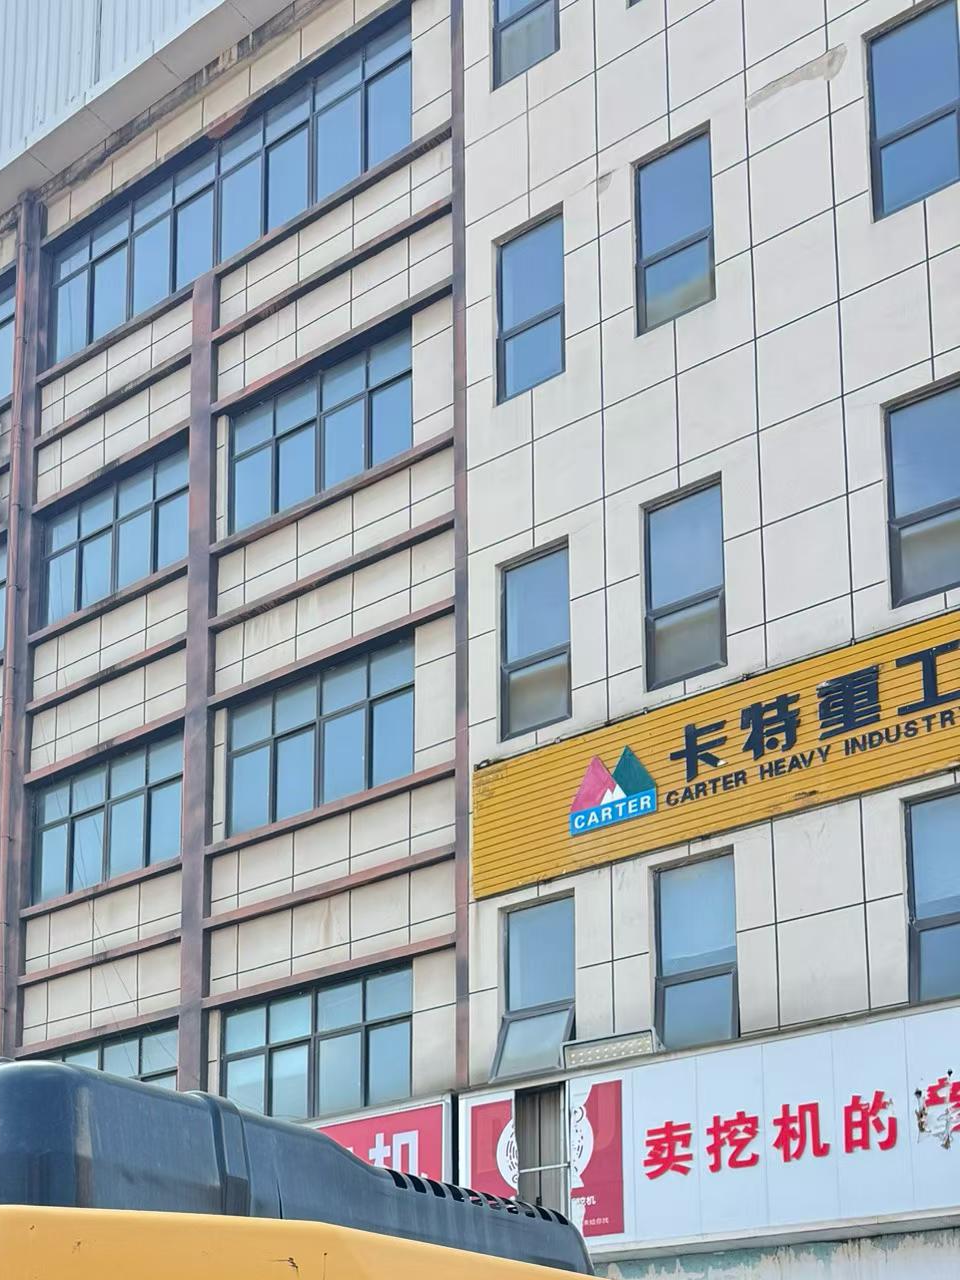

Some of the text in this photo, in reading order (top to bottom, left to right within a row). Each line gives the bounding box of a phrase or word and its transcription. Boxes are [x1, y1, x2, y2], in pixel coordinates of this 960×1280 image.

[666, 706, 960, 806] CARTER HEAVY INDUSTR
[670, 640, 960, 783] 卡特重工
[574, 795, 651, 829] CARTER
